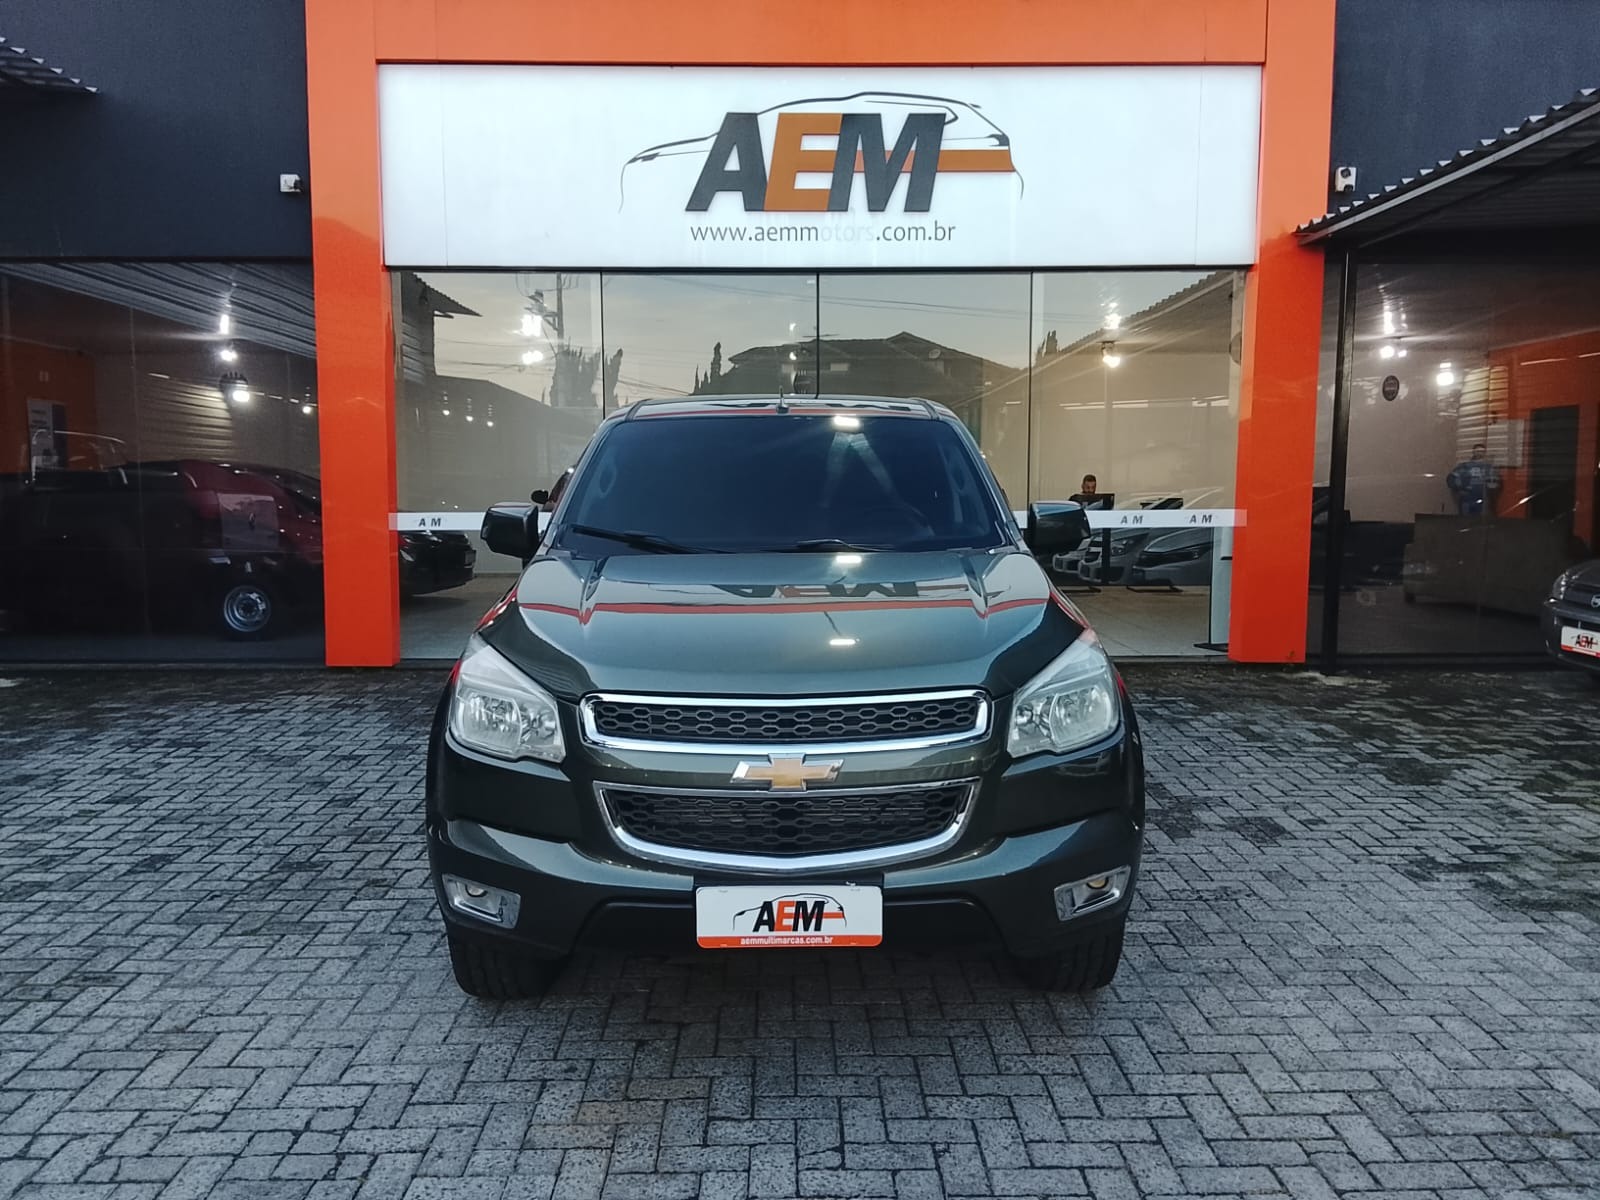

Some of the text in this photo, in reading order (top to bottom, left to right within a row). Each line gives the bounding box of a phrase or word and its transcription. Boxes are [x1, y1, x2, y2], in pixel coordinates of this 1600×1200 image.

[685, 112, 947, 212] AEM
[752, 900, 826, 933] AEM
[740, 934, 834, 946] aemmultimarcas.com.br
